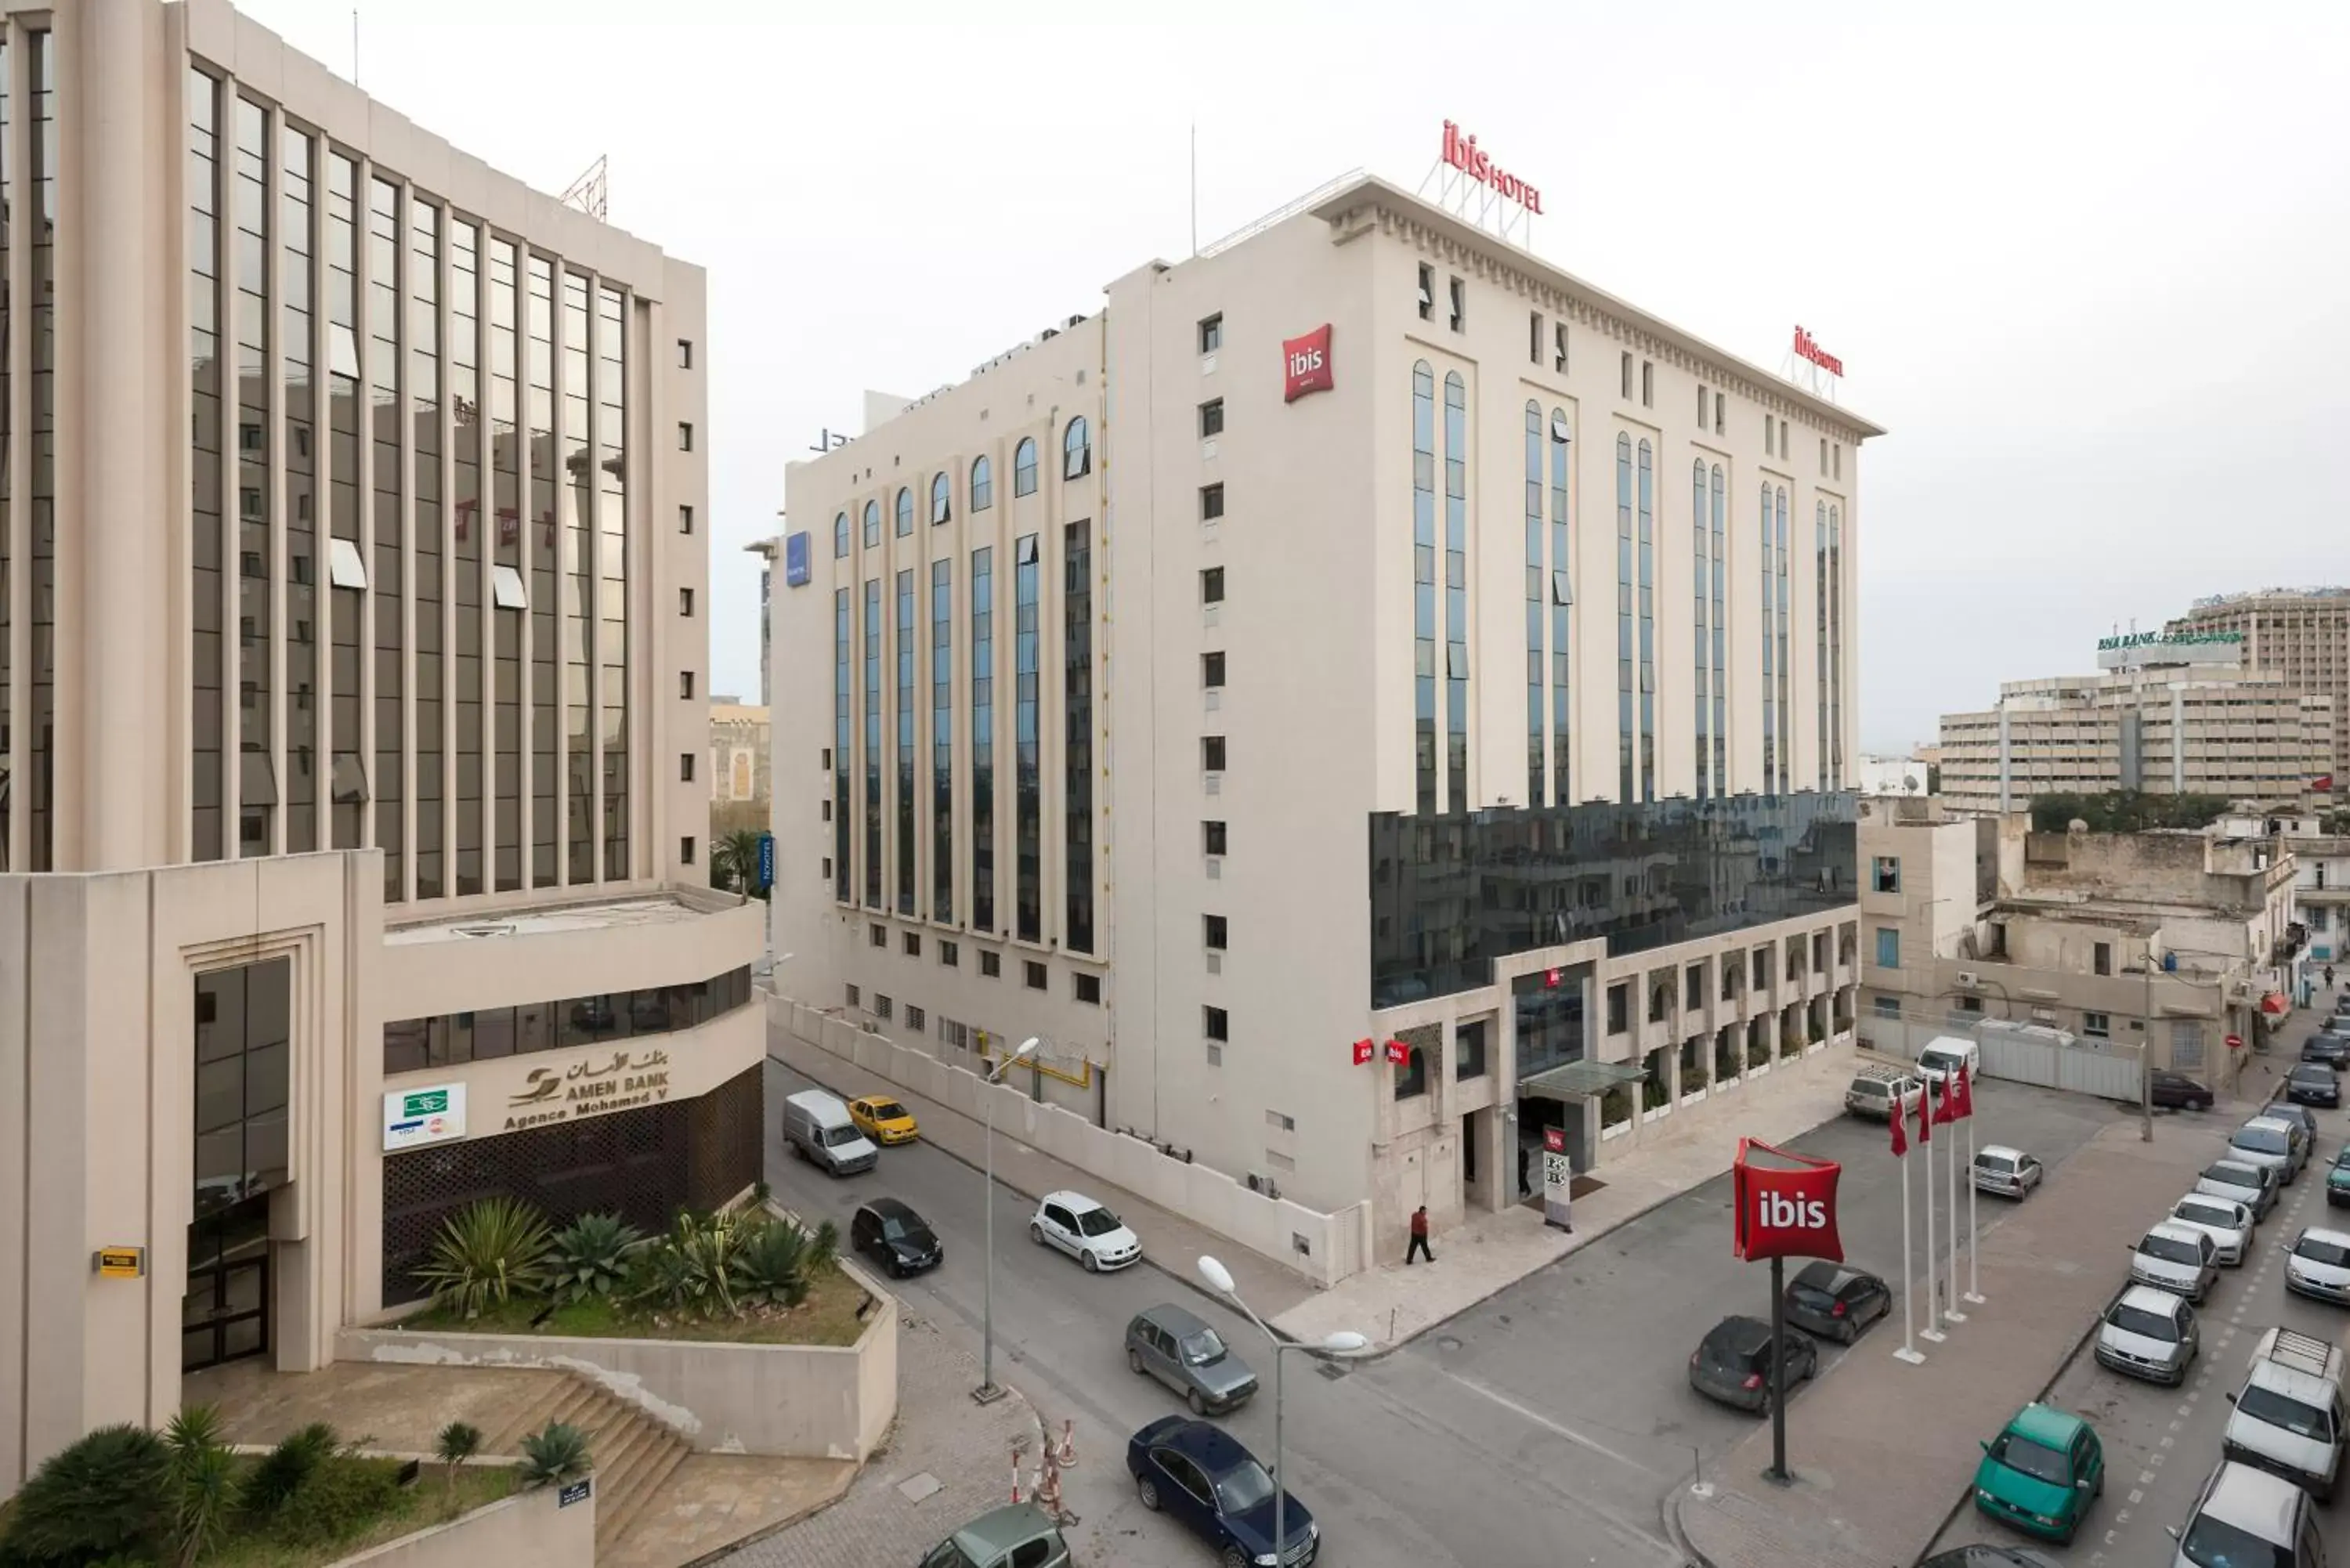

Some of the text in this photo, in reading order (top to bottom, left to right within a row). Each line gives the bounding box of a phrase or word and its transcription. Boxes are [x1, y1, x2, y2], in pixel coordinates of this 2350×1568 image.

[1443, 119, 1544, 215] ibis HOTEL
[1290, 347, 1323, 378] ibis
[1795, 325, 1818, 364] ibis
[566, 1071, 670, 1102] AMEN BANK
[504, 1110, 567, 1132] Agence
[658, 1089, 668, 1100] V
[1760, 1190, 1827, 1229] ibis
